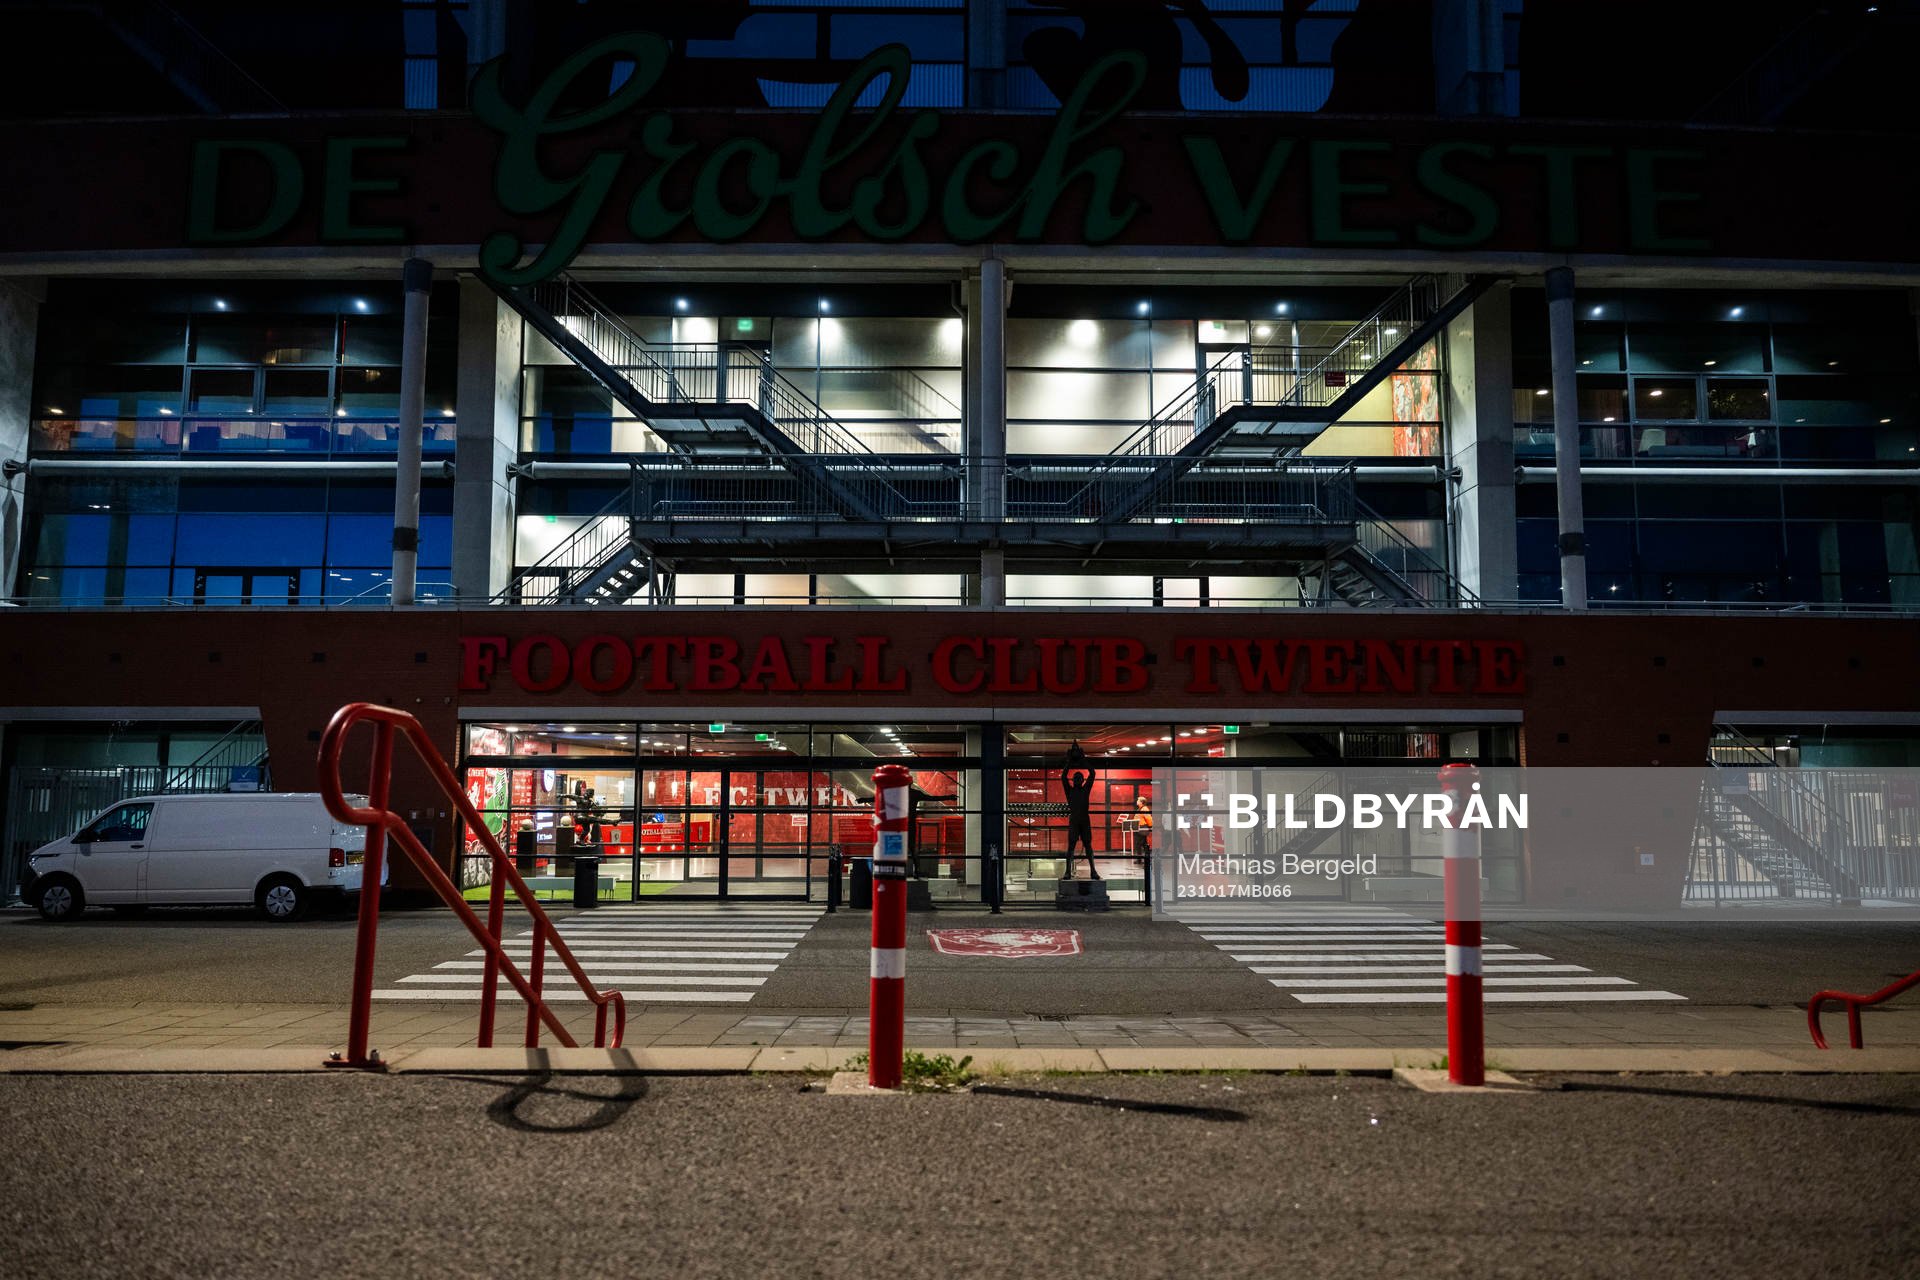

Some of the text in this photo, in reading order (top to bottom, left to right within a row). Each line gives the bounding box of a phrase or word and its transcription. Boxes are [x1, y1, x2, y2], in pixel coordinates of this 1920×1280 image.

[184, 30, 1715, 287] DE Grolsch VESTE
[457, 633, 1530, 697] FOOTBALL CLUB TWENTE
[763, 786, 866, 807] TWEN
